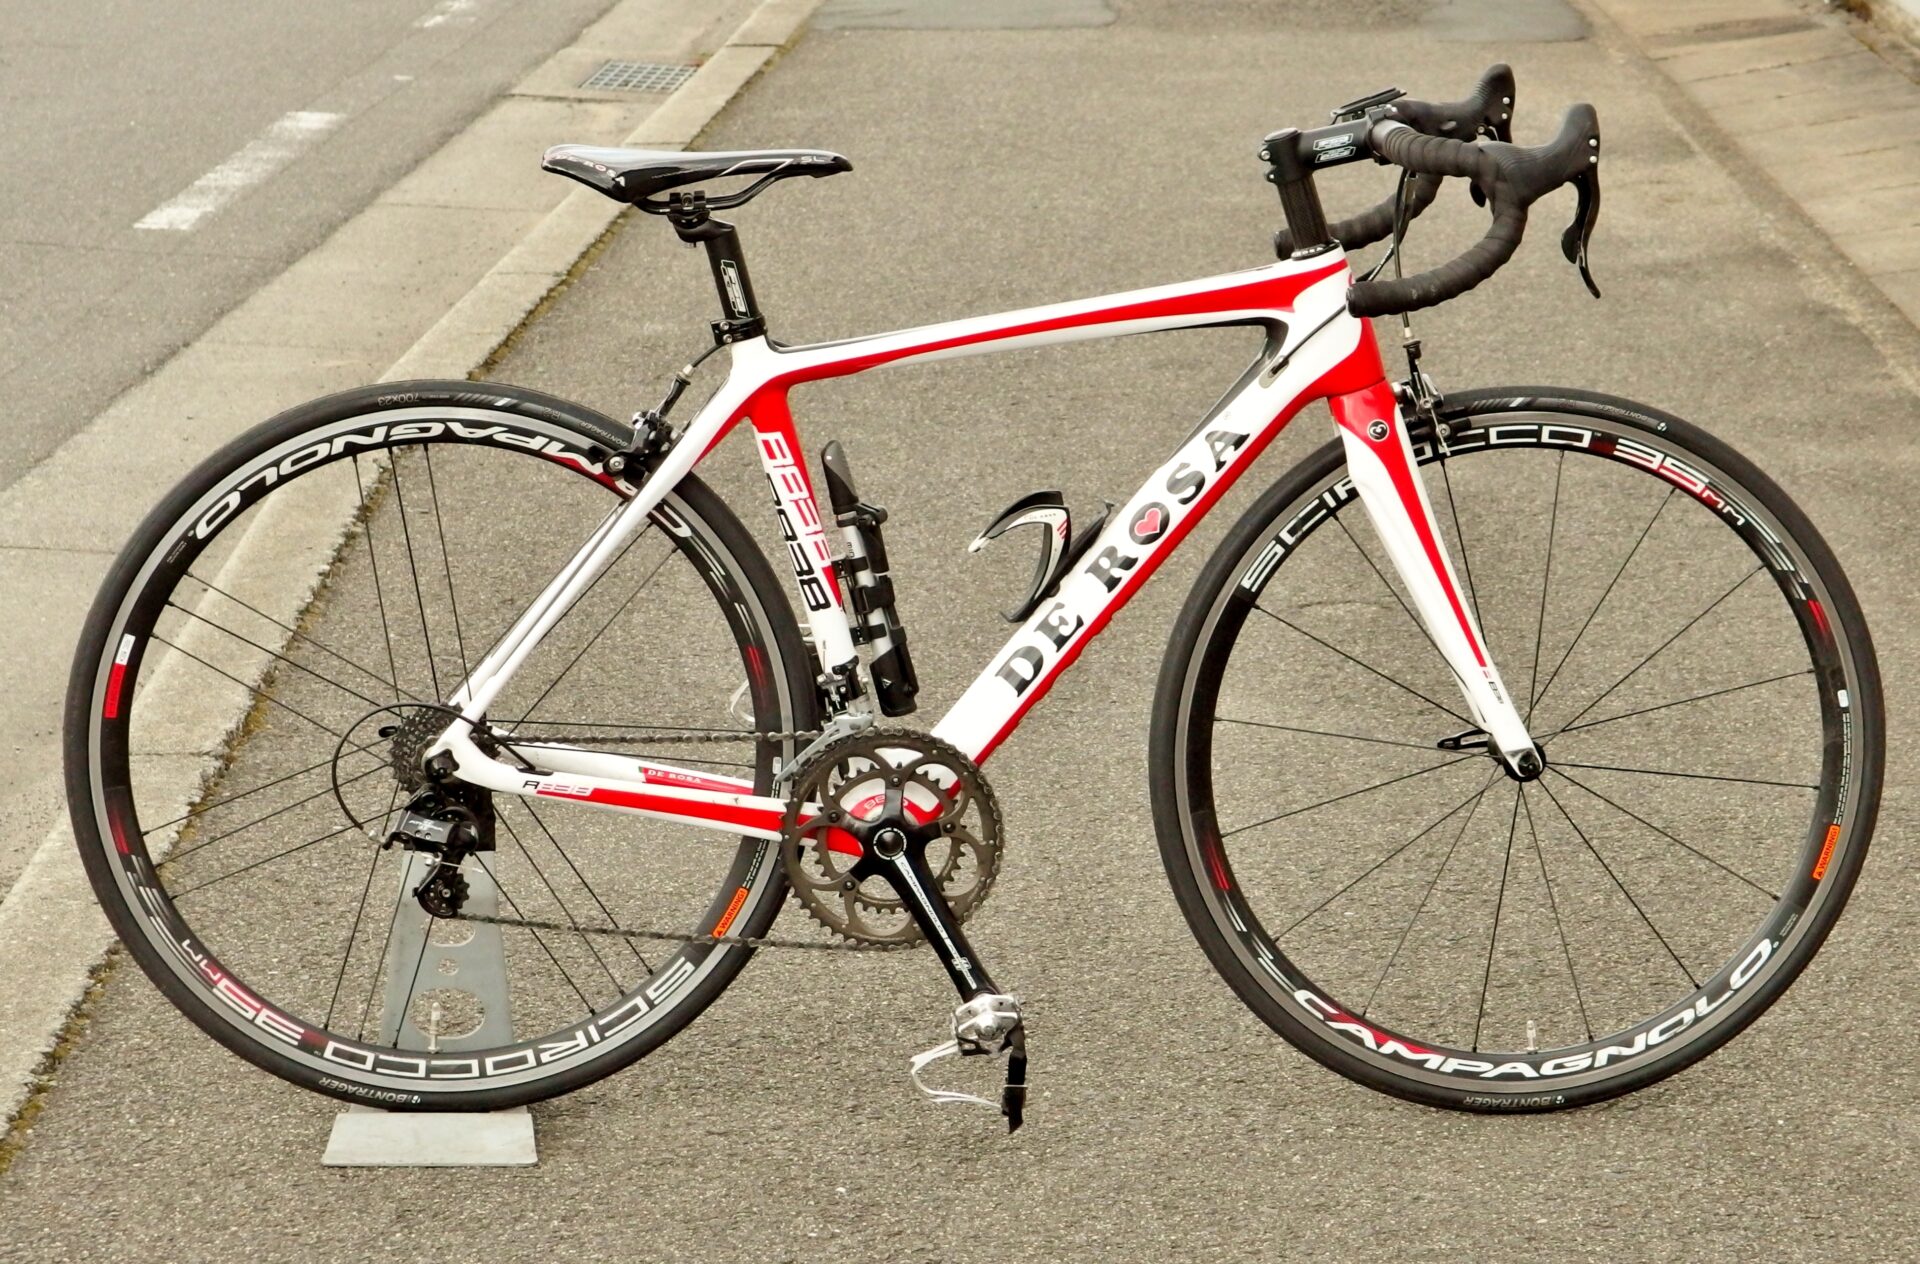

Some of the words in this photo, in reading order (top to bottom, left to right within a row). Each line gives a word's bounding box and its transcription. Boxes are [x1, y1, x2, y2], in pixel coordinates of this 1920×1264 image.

[800, 155, 826, 164] SL
[377, 393, 420, 406] 700x23
[995, 602, 1085, 698] DE
[1085, 429, 1252, 594] ROSA
[647, 768, 664, 778] DE
[668, 773, 703, 784] ROSA
[720, 888, 746, 929] WARNING!
[323, 956, 696, 1079] SCIROCCO
[1293, 937, 1772, 1079] CAMPAGNOLO
[319, 1076, 410, 1105] BONTRAGER
[1464, 1095, 1551, 1110] BONTRAGER
